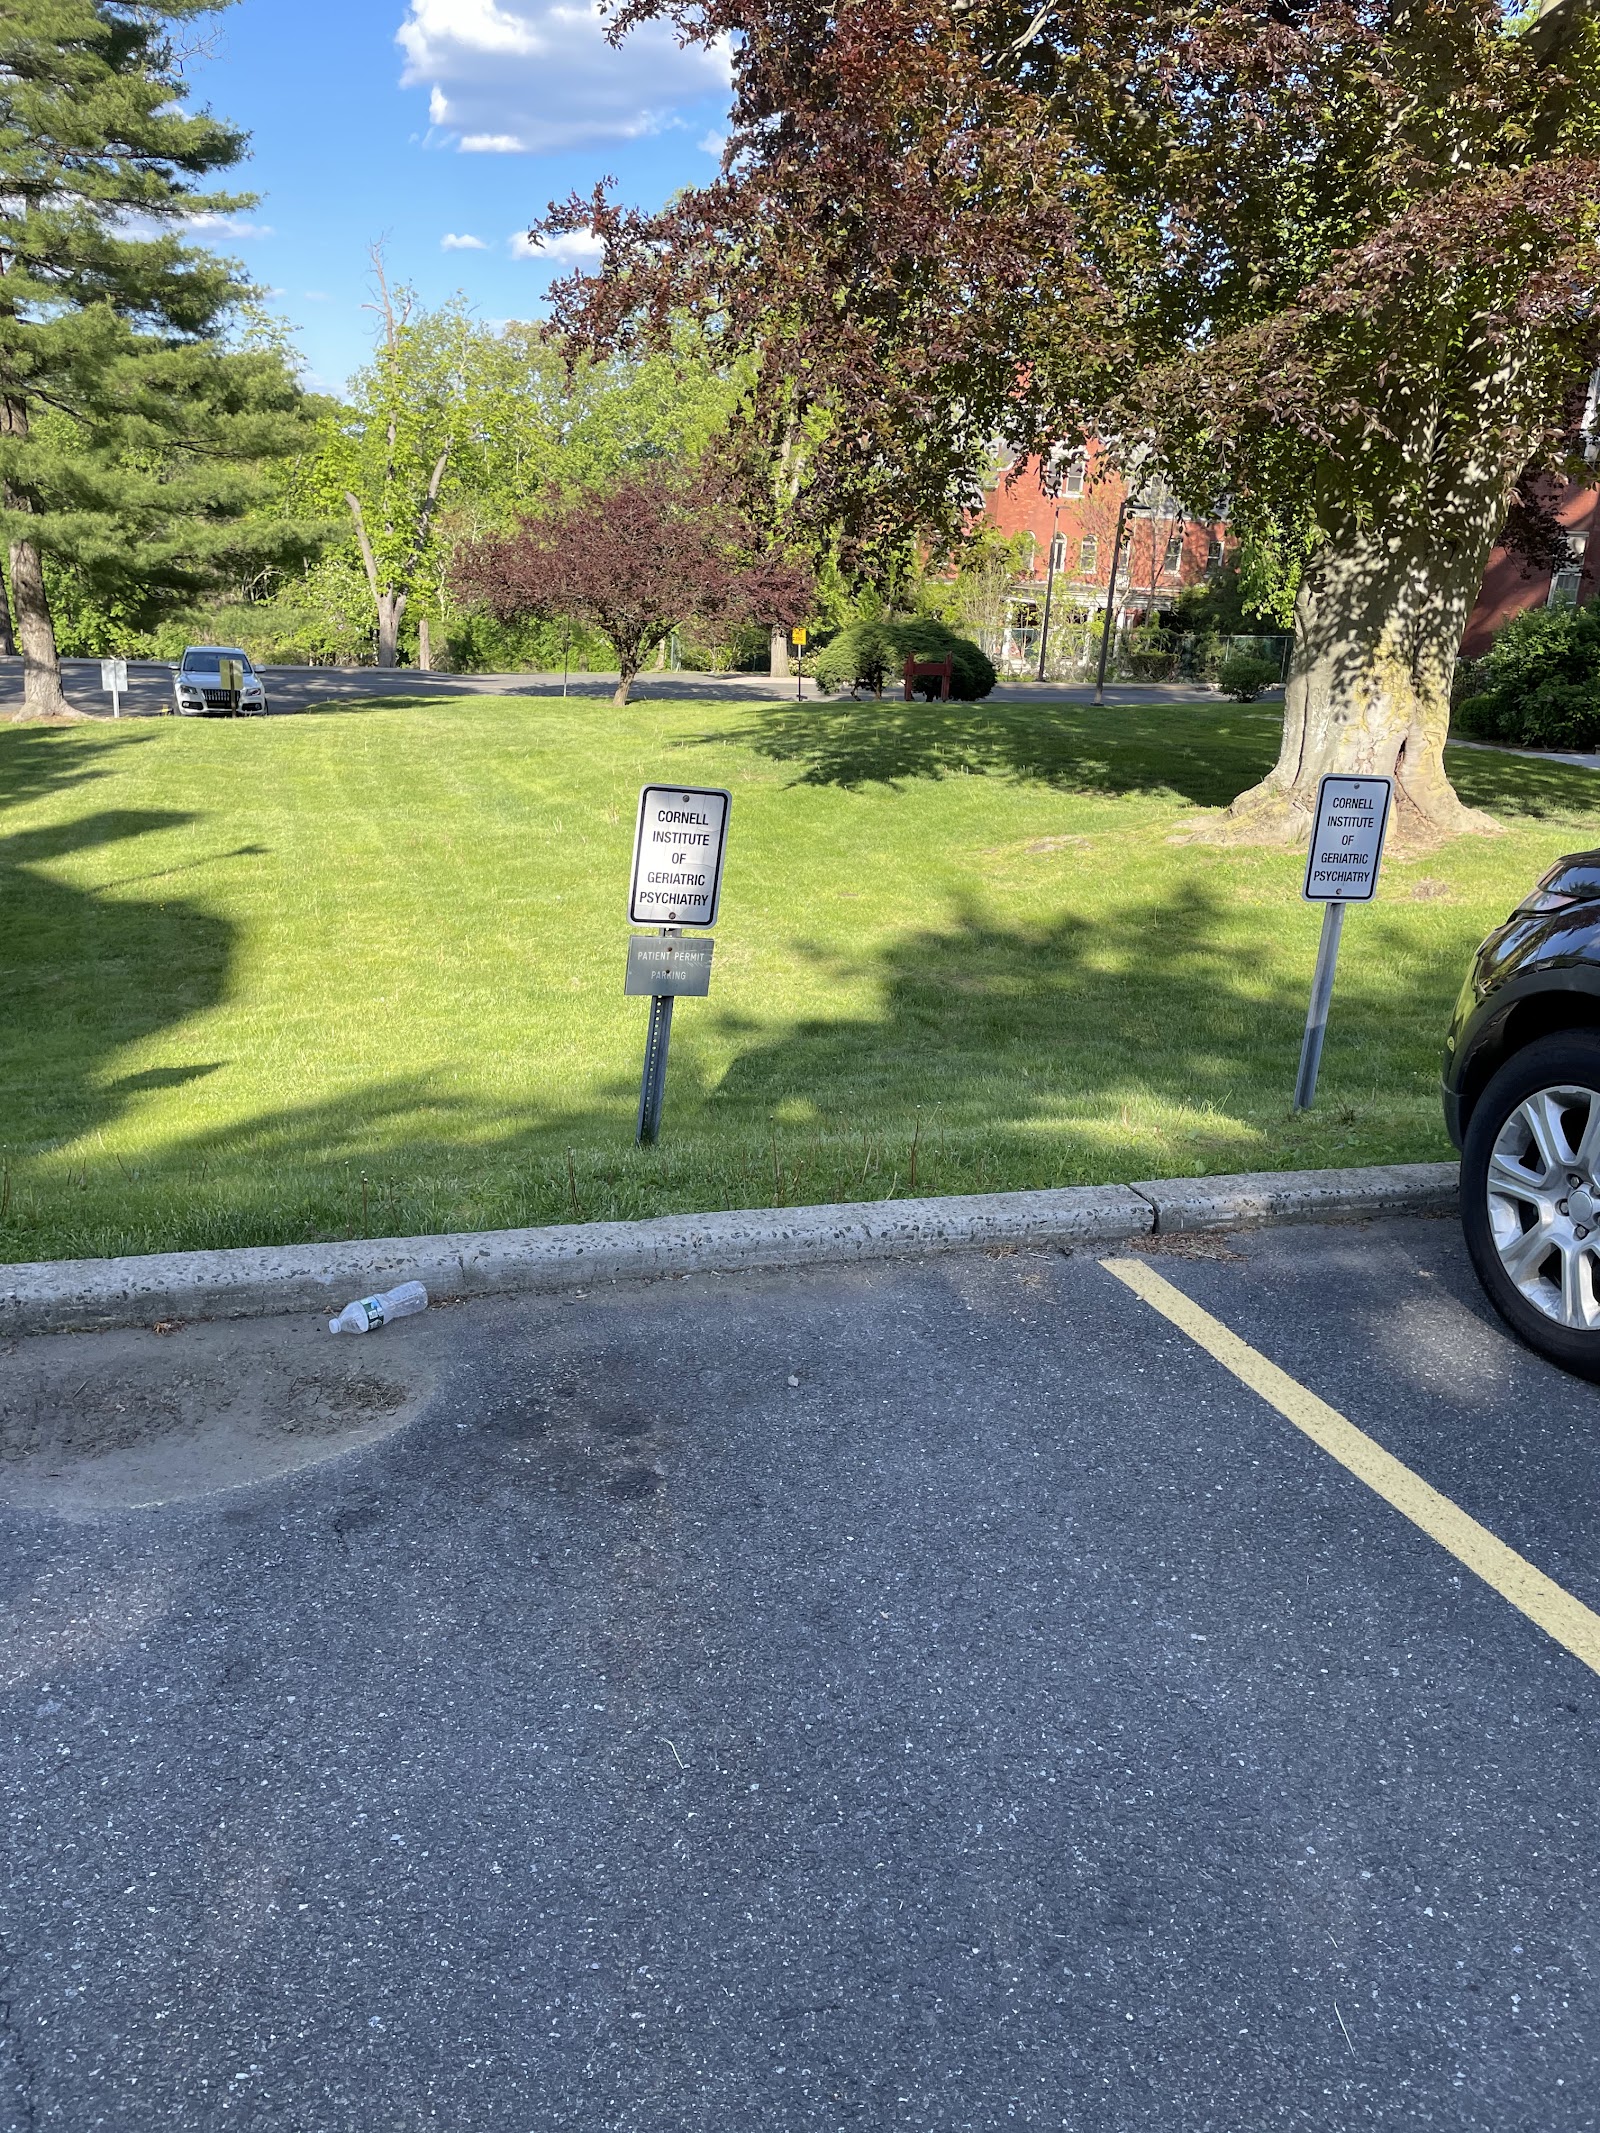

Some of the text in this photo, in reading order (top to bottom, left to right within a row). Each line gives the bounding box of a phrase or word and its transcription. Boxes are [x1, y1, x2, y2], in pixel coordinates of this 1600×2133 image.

[1332, 797, 1374, 810] CORNELL
[657, 809, 709, 826] CORNELL
[1327, 816, 1374, 828] INSTITUTE
[652, 830, 710, 846] INSTITUTE
[1341, 834, 1354, 845] OF
[671, 852, 687, 865] OF
[1321, 852, 1369, 864] GERIATRIC
[647, 871, 706, 886] GERIATRIC
[1313, 870, 1370, 882] PSYCHIATRY
[639, 891, 709, 906] PSYCHIATRY
[637, 951, 705, 962] PATIENT PERMIT
[651, 970, 686, 980] PARKING
